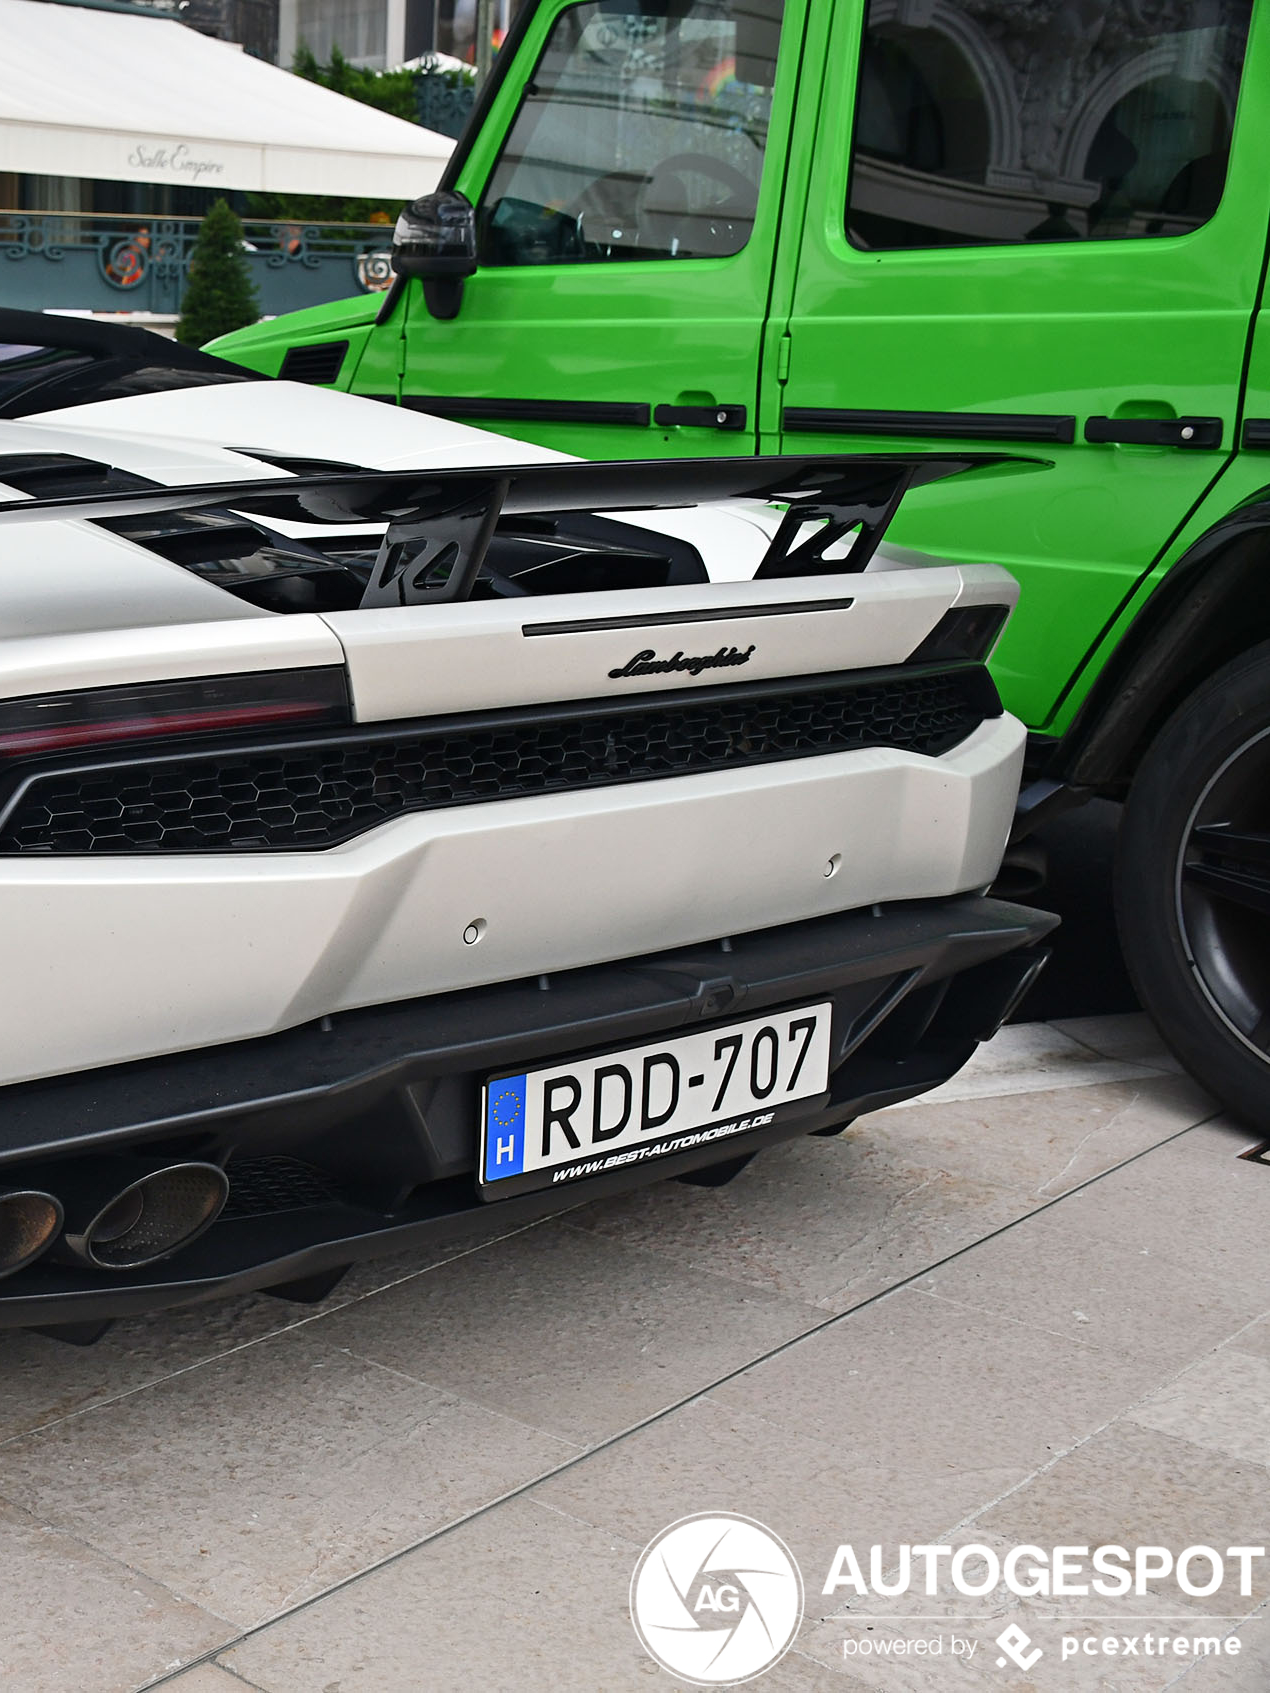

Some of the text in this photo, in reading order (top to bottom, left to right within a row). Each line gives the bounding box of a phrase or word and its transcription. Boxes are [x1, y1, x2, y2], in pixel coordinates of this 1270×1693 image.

[128, 144, 224, 181] Salle Empire
[607, 644, 756, 679] Lamborghini
[541, 1015, 817, 1157] RDD-707
[496, 1134, 514, 1165] H
[552, 1112, 775, 1182] WWW.BEST-AUTOMOBILE.DE
